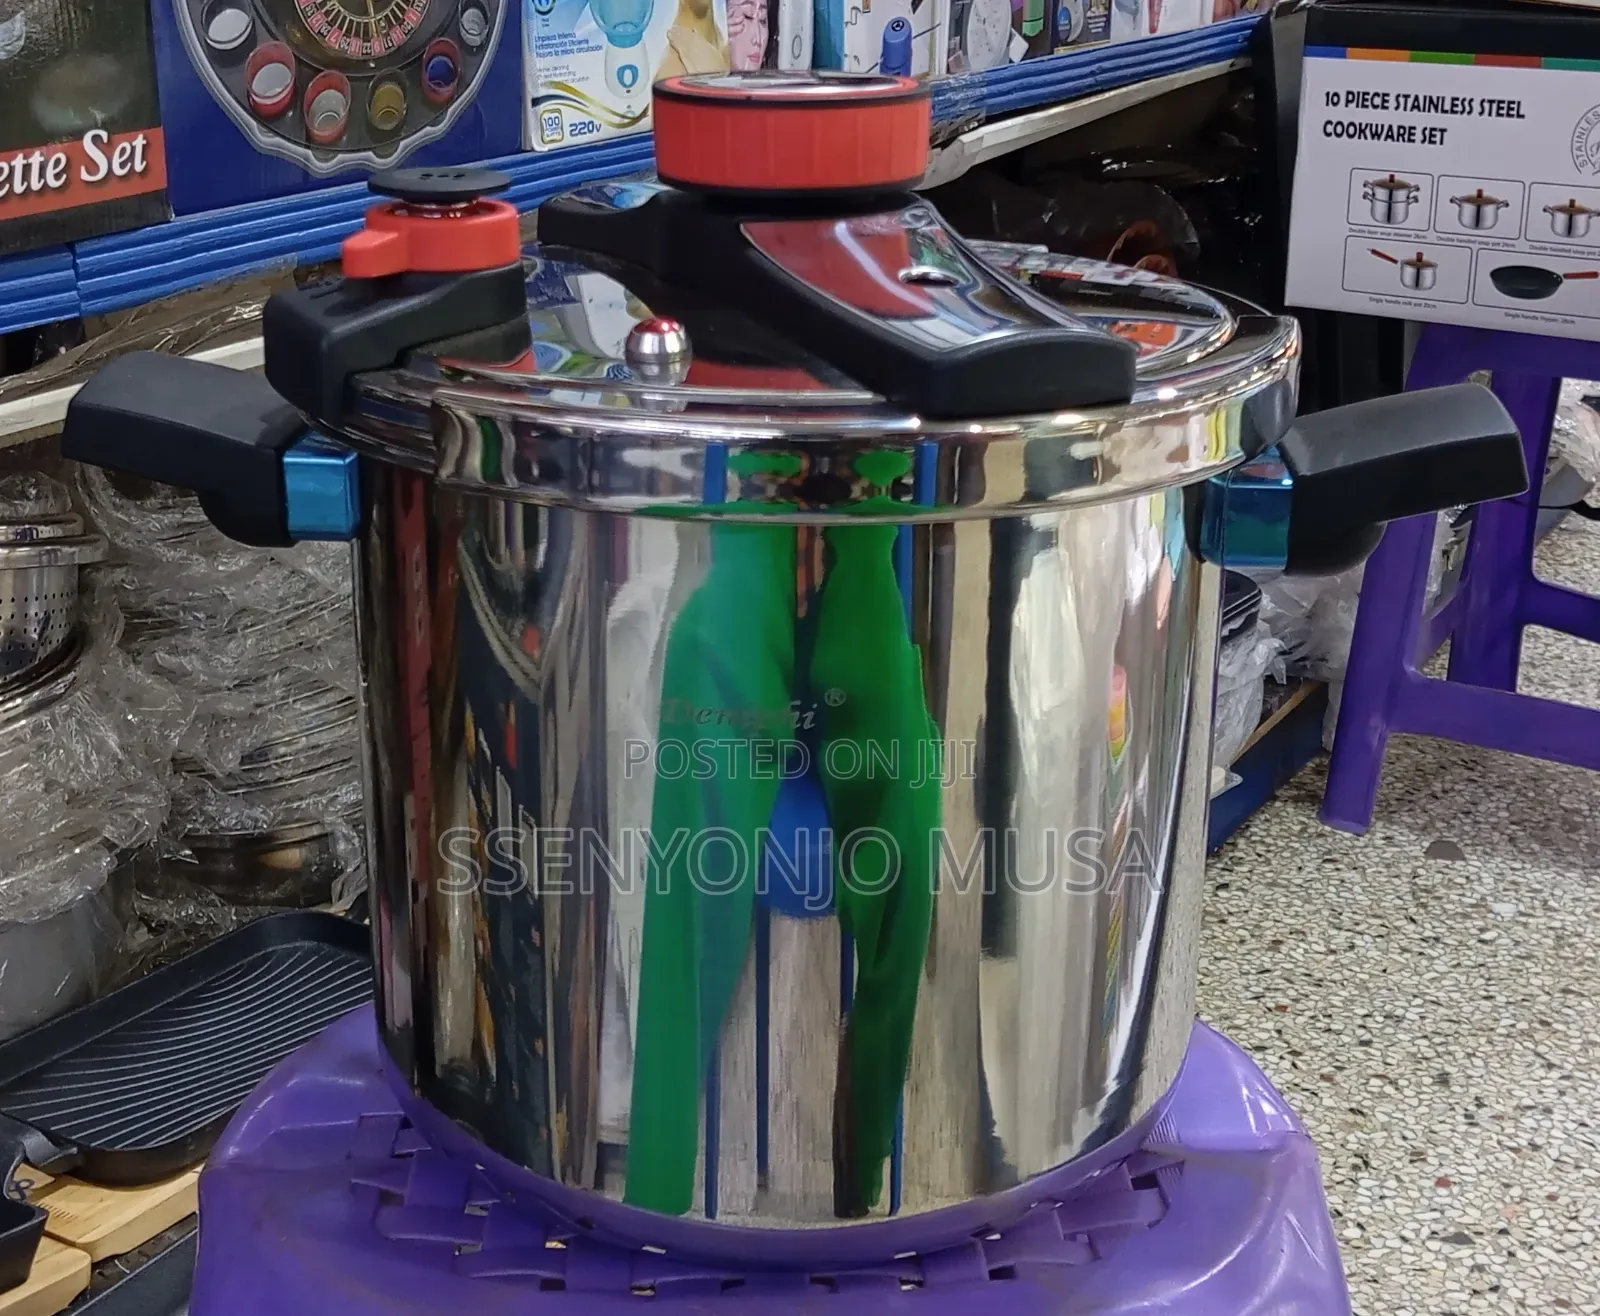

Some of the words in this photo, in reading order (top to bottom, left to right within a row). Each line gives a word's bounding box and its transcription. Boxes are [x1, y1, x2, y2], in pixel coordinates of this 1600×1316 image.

[362, 42, 371, 54] 22
[1325, 91, 1340, 107] 10
[1345, 91, 1390, 111] PIECE
[1394, 93, 1474, 116] STAINLESS
[1478, 98, 1525, 119] STEEL
[543, 115, 560, 129] 100
[1323, 120, 1416, 144] COOKWARE
[1420, 126, 1448, 146] SET
[80, 129, 147, 182] Set
